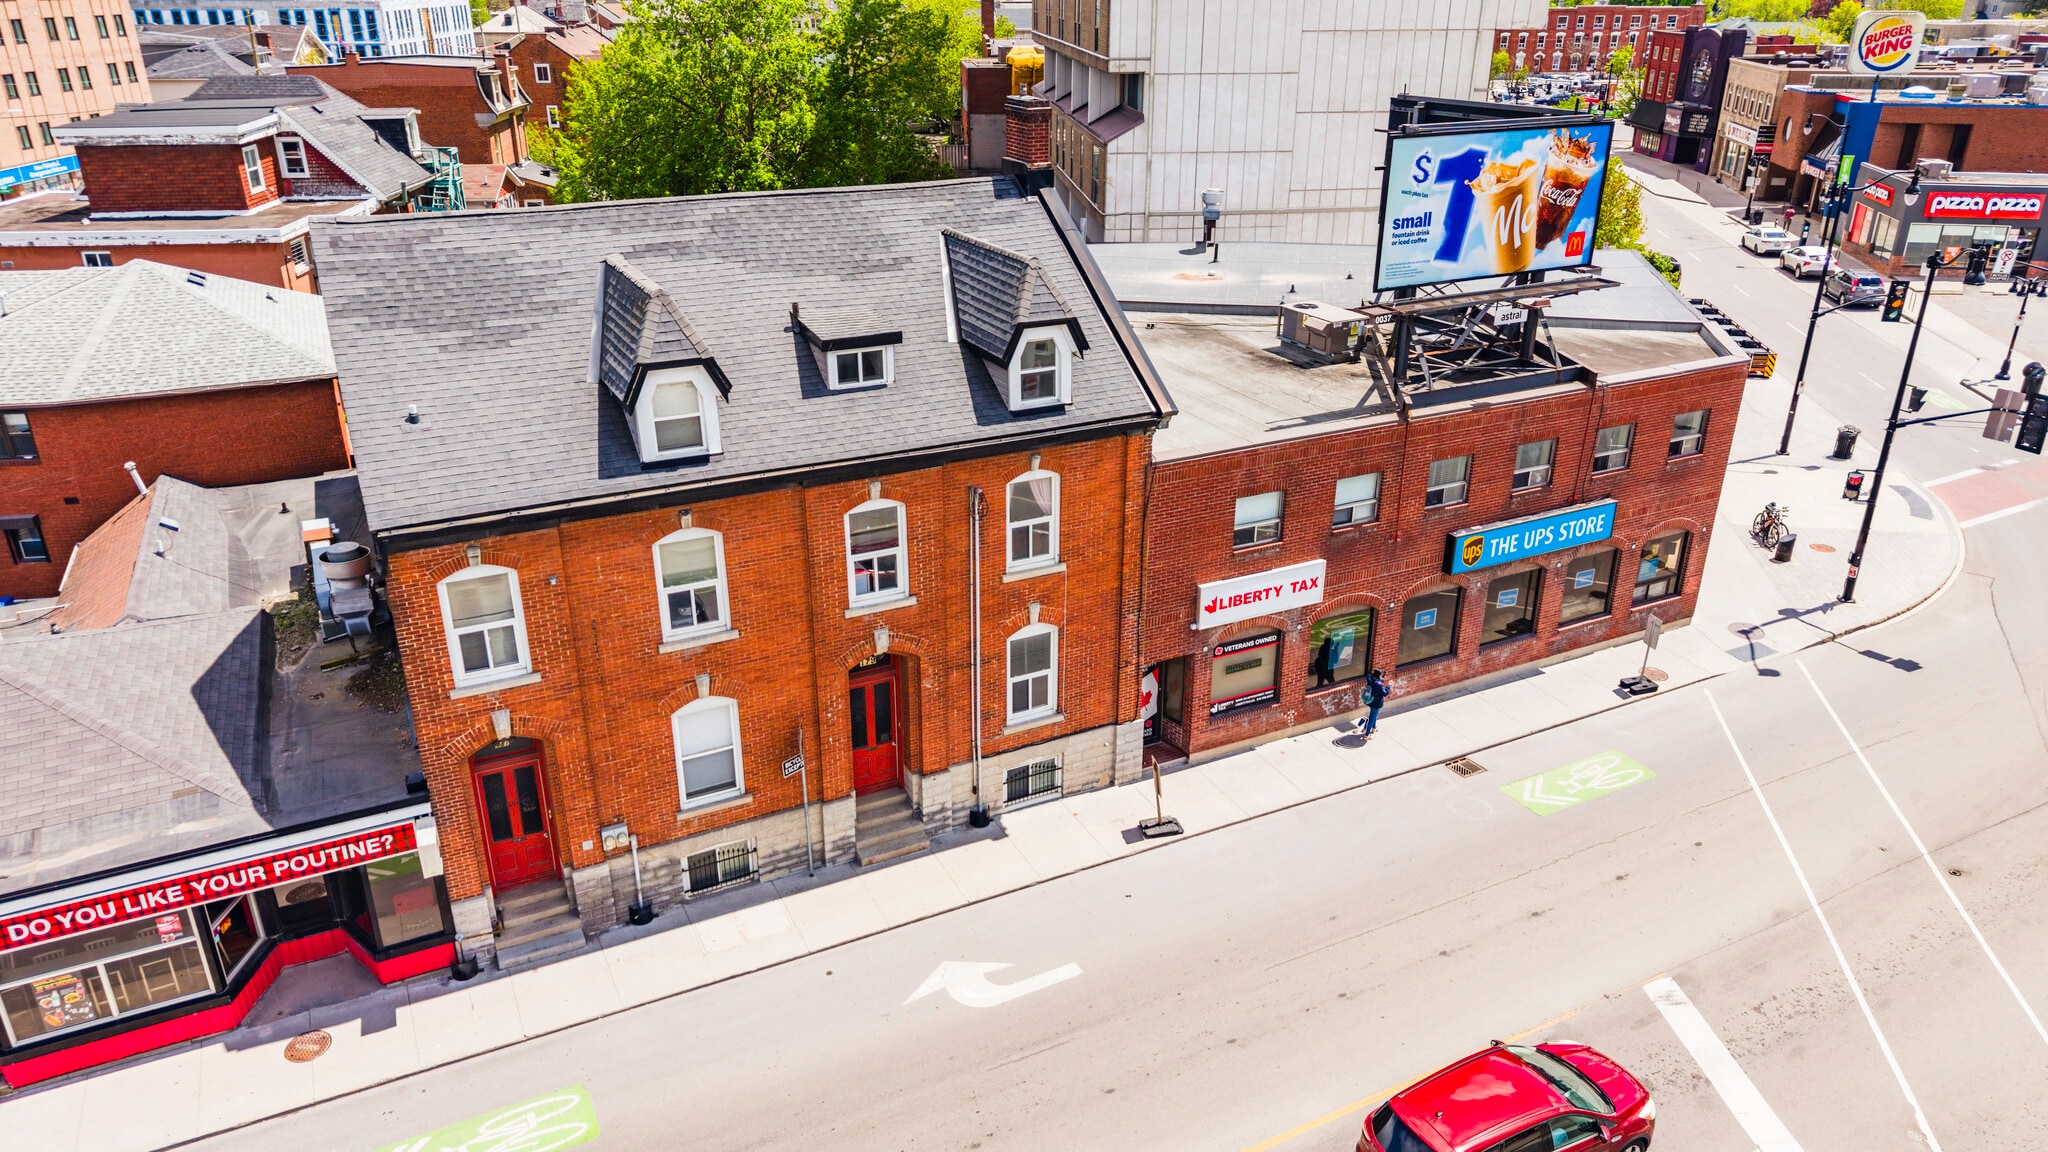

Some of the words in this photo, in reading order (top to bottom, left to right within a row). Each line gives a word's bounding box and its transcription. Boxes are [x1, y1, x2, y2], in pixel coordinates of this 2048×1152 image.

[1865, 25, 1912, 46] BURGER
[1864, 35, 1913, 60] KING
[1411, 190, 1421, 198] plus
[1930, 196, 1984, 214] pizza
[1985, 197, 2041, 215] pizza
[1392, 212, 1432, 230] small
[1392, 230, 1415, 239] fountain
[1416, 229, 1430, 237] drink
[1398, 238, 1410, 246] iced
[1411, 237, 1428, 245] coffee
[1375, 314, 1392, 325] 0037
[1501, 311, 1522, 321] astral
[1463, 544, 1482, 563] ups
[1490, 534, 1520, 557] THE
[1523, 526, 1554, 549] UPS
[1559, 514, 1606, 541] STORE
[1219, 585, 1284, 610] LIBERTY
[1290, 577, 1319, 593] TAX
[1224, 640, 1255, 652] VETERANS
[1255, 635, 1277, 645] OWNED
[7, 918, 52, 942] DO
[54, 902, 117, 929] YOU
[123, 885, 184, 914] LIKE
[190, 866, 266, 896] YOUR
[272, 835, 394, 877] POUTINE?
